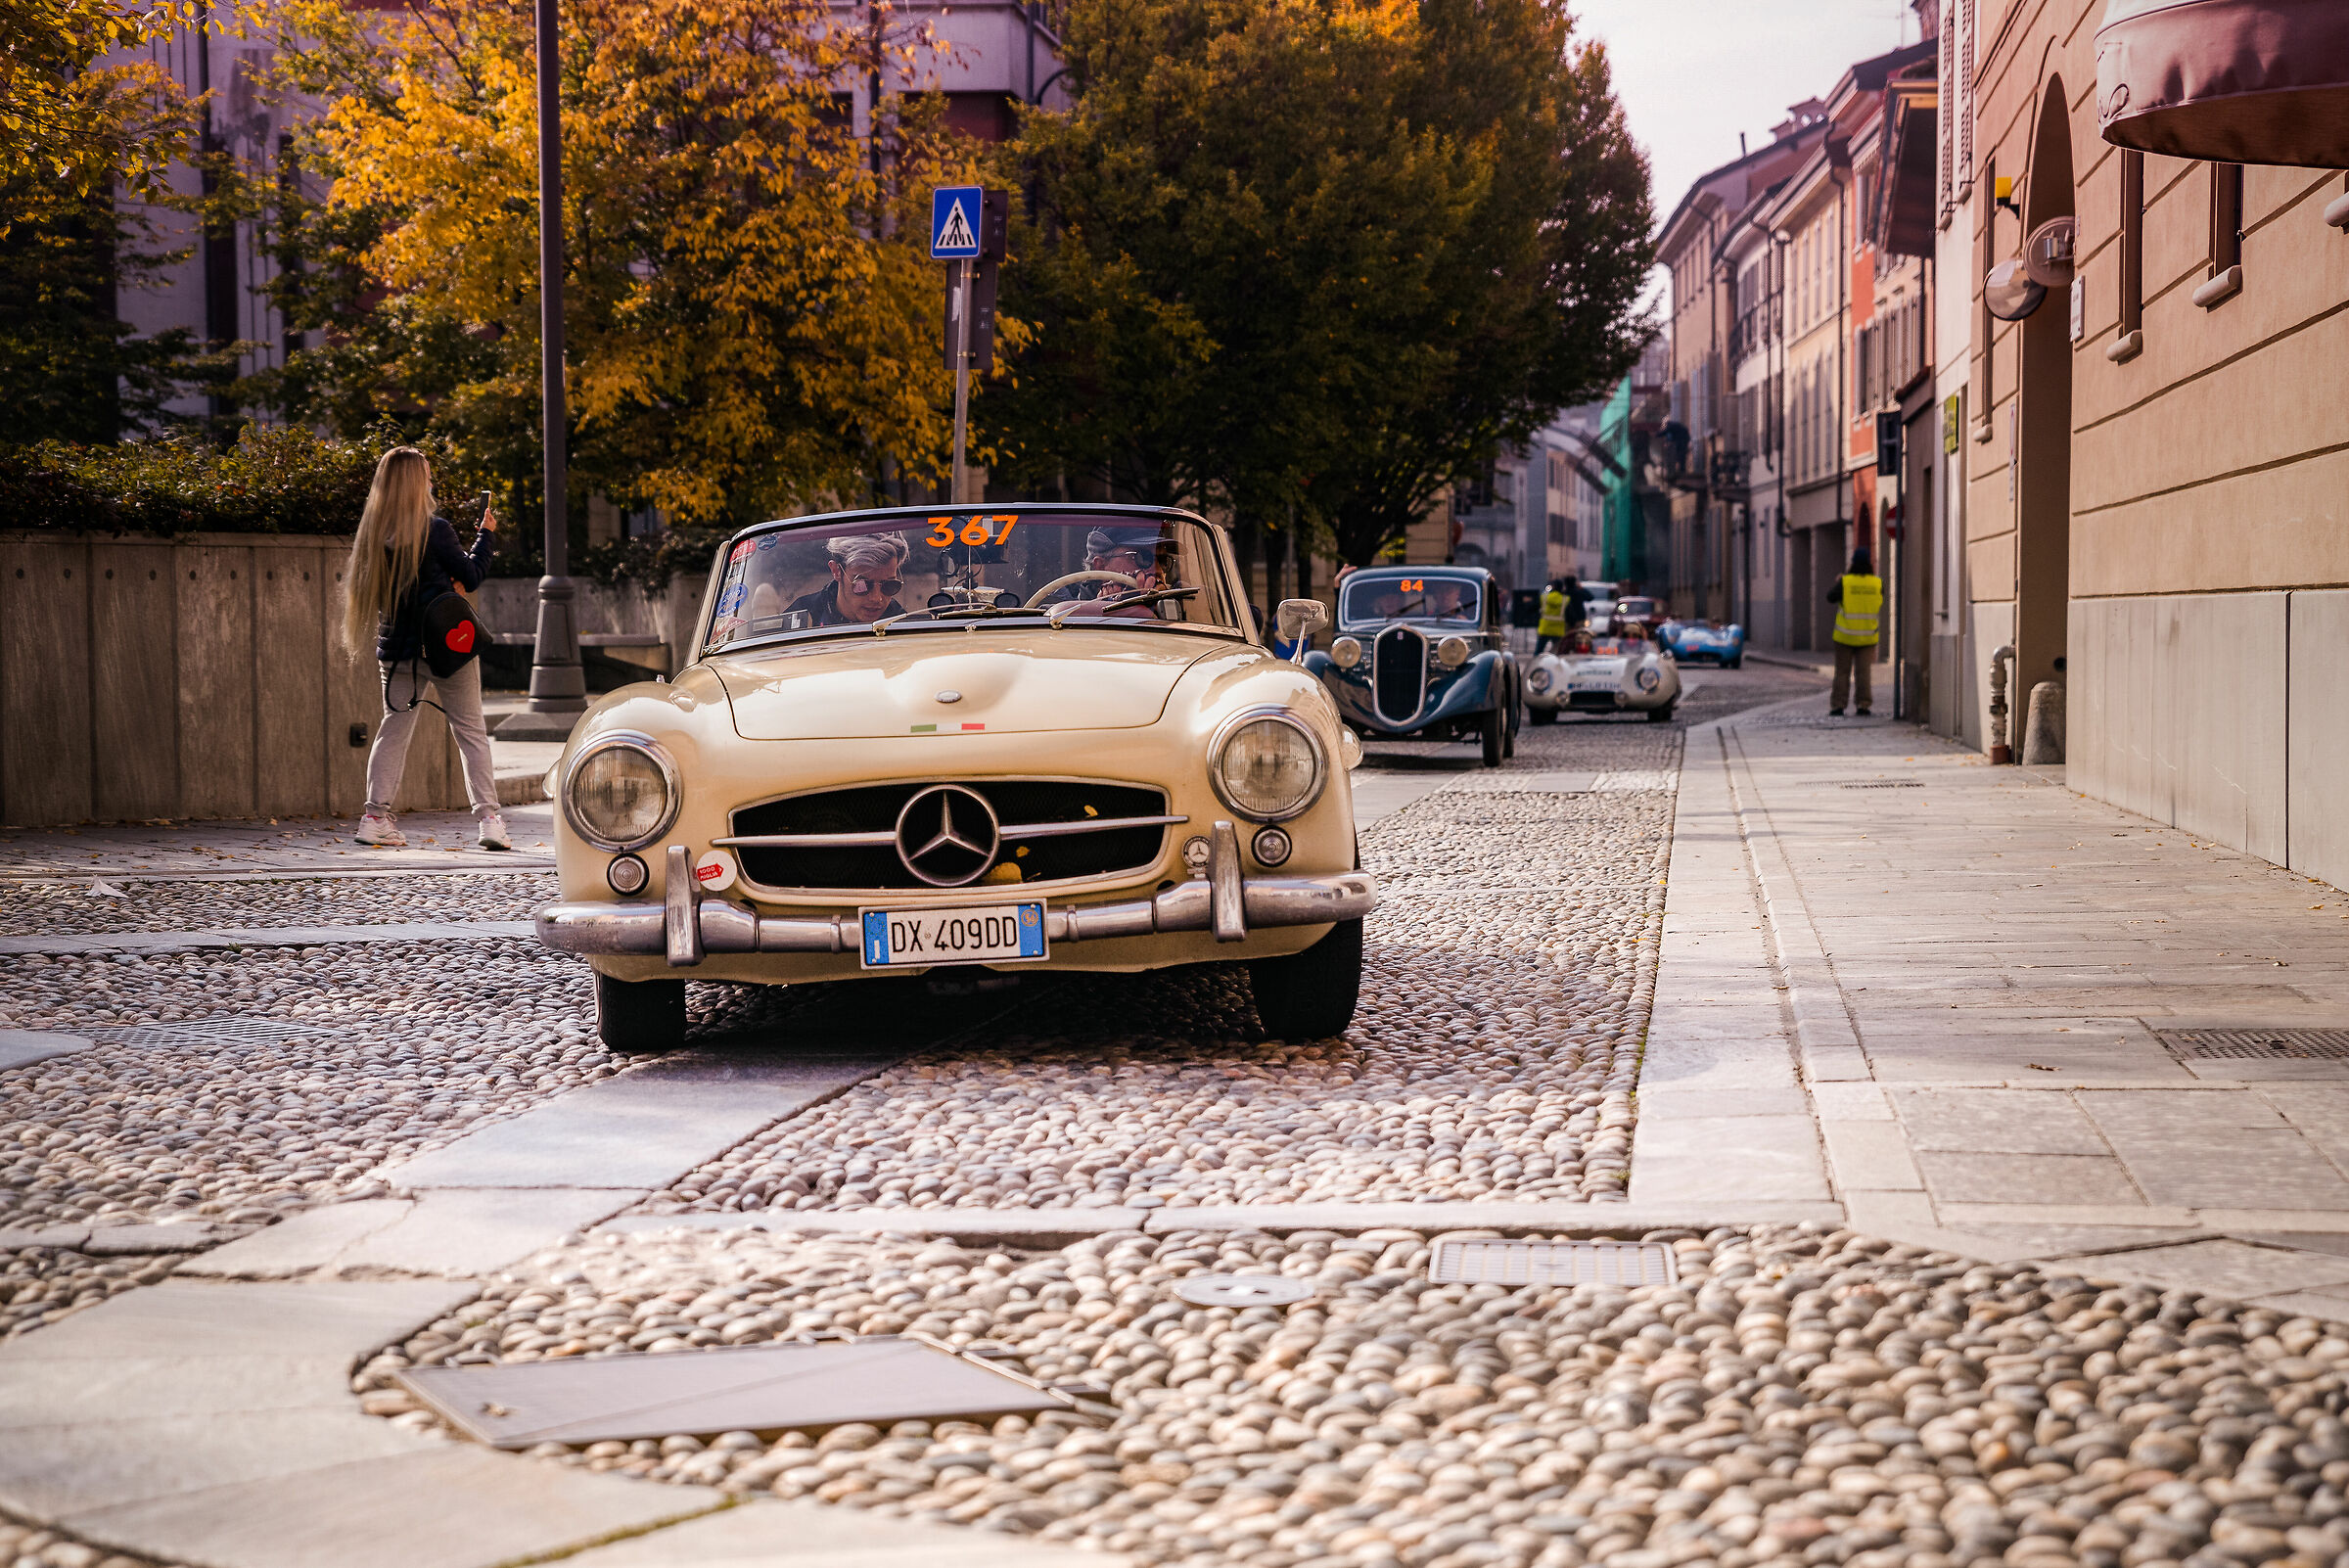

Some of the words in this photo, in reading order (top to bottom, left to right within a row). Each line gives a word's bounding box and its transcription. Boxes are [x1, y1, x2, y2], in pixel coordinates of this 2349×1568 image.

[925, 514, 1019, 548] 367
[1400, 578, 1424, 592] 84
[891, 920, 924, 953] DX
[934, 916, 1018, 951] 409DD
